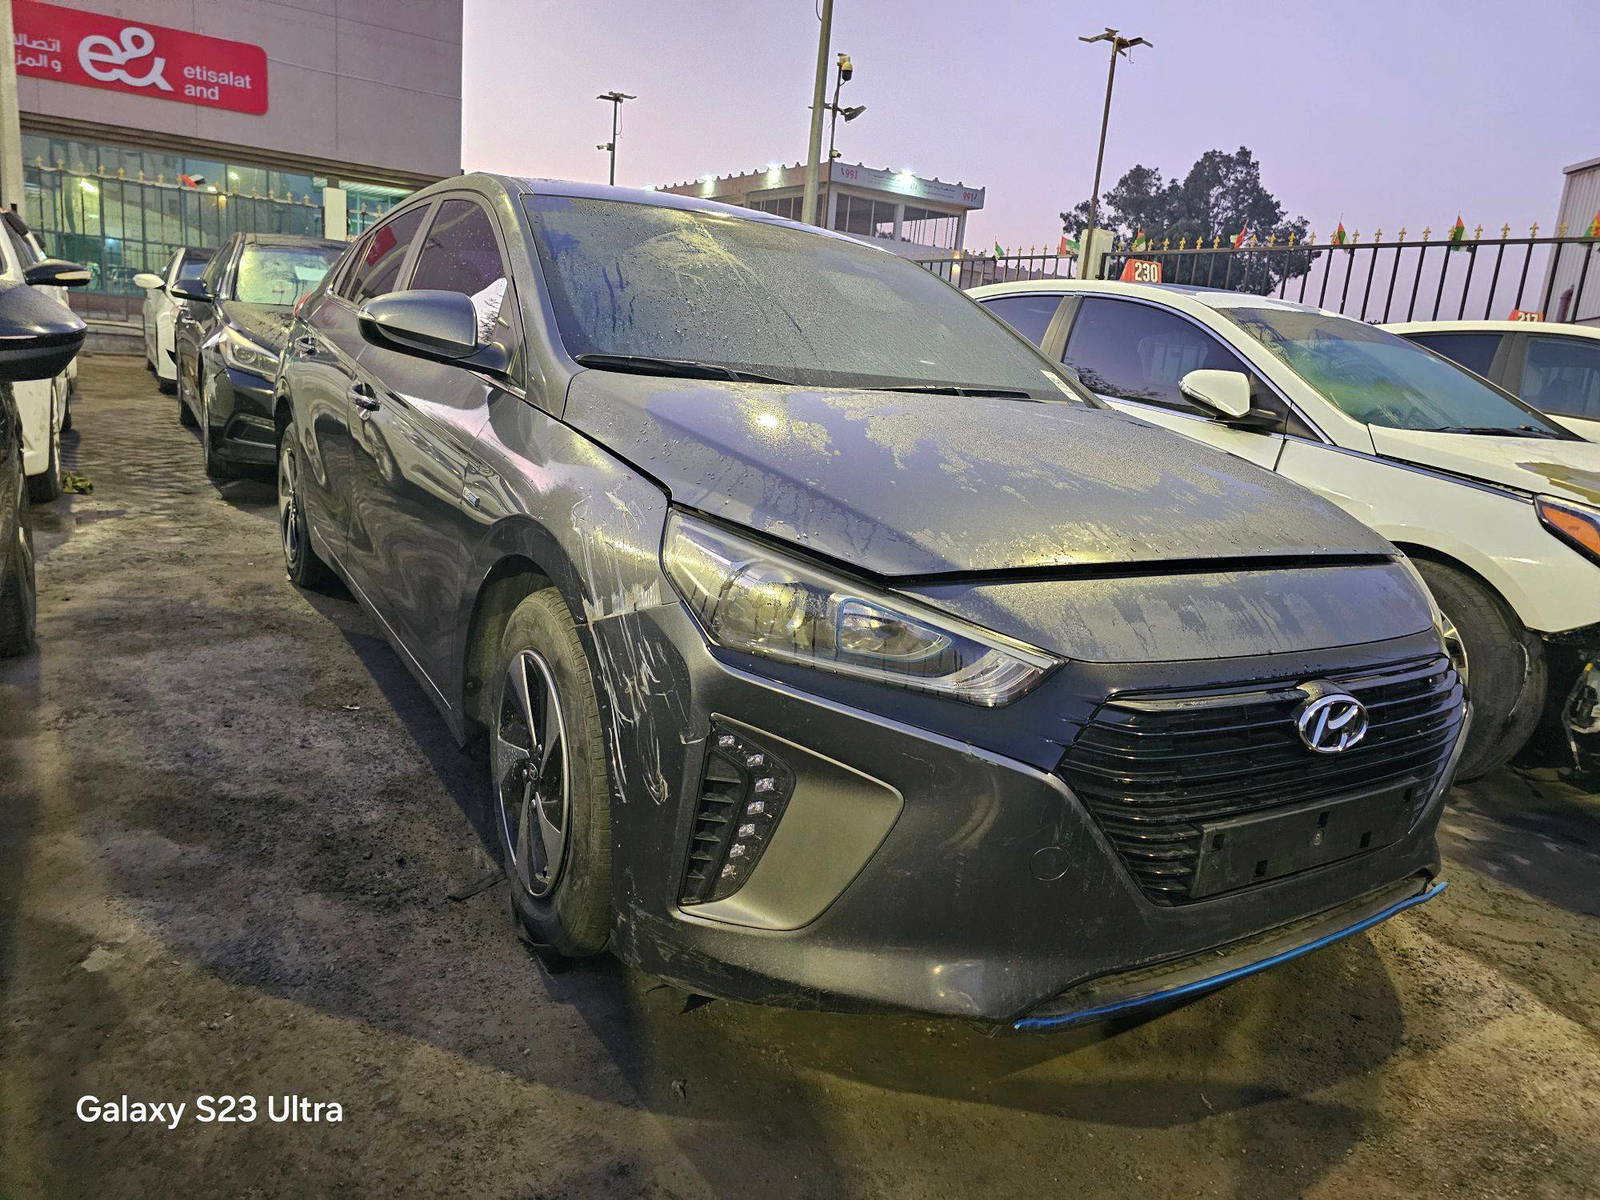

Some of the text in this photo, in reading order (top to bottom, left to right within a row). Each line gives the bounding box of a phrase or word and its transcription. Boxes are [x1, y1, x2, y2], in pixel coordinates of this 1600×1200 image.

[15, 33, 61, 52] اتصال
[16, 49, 48, 67] المز
[183, 65, 252, 89] etisalat
[184, 83, 220, 101] and
[1134, 262, 1158, 282] 230
